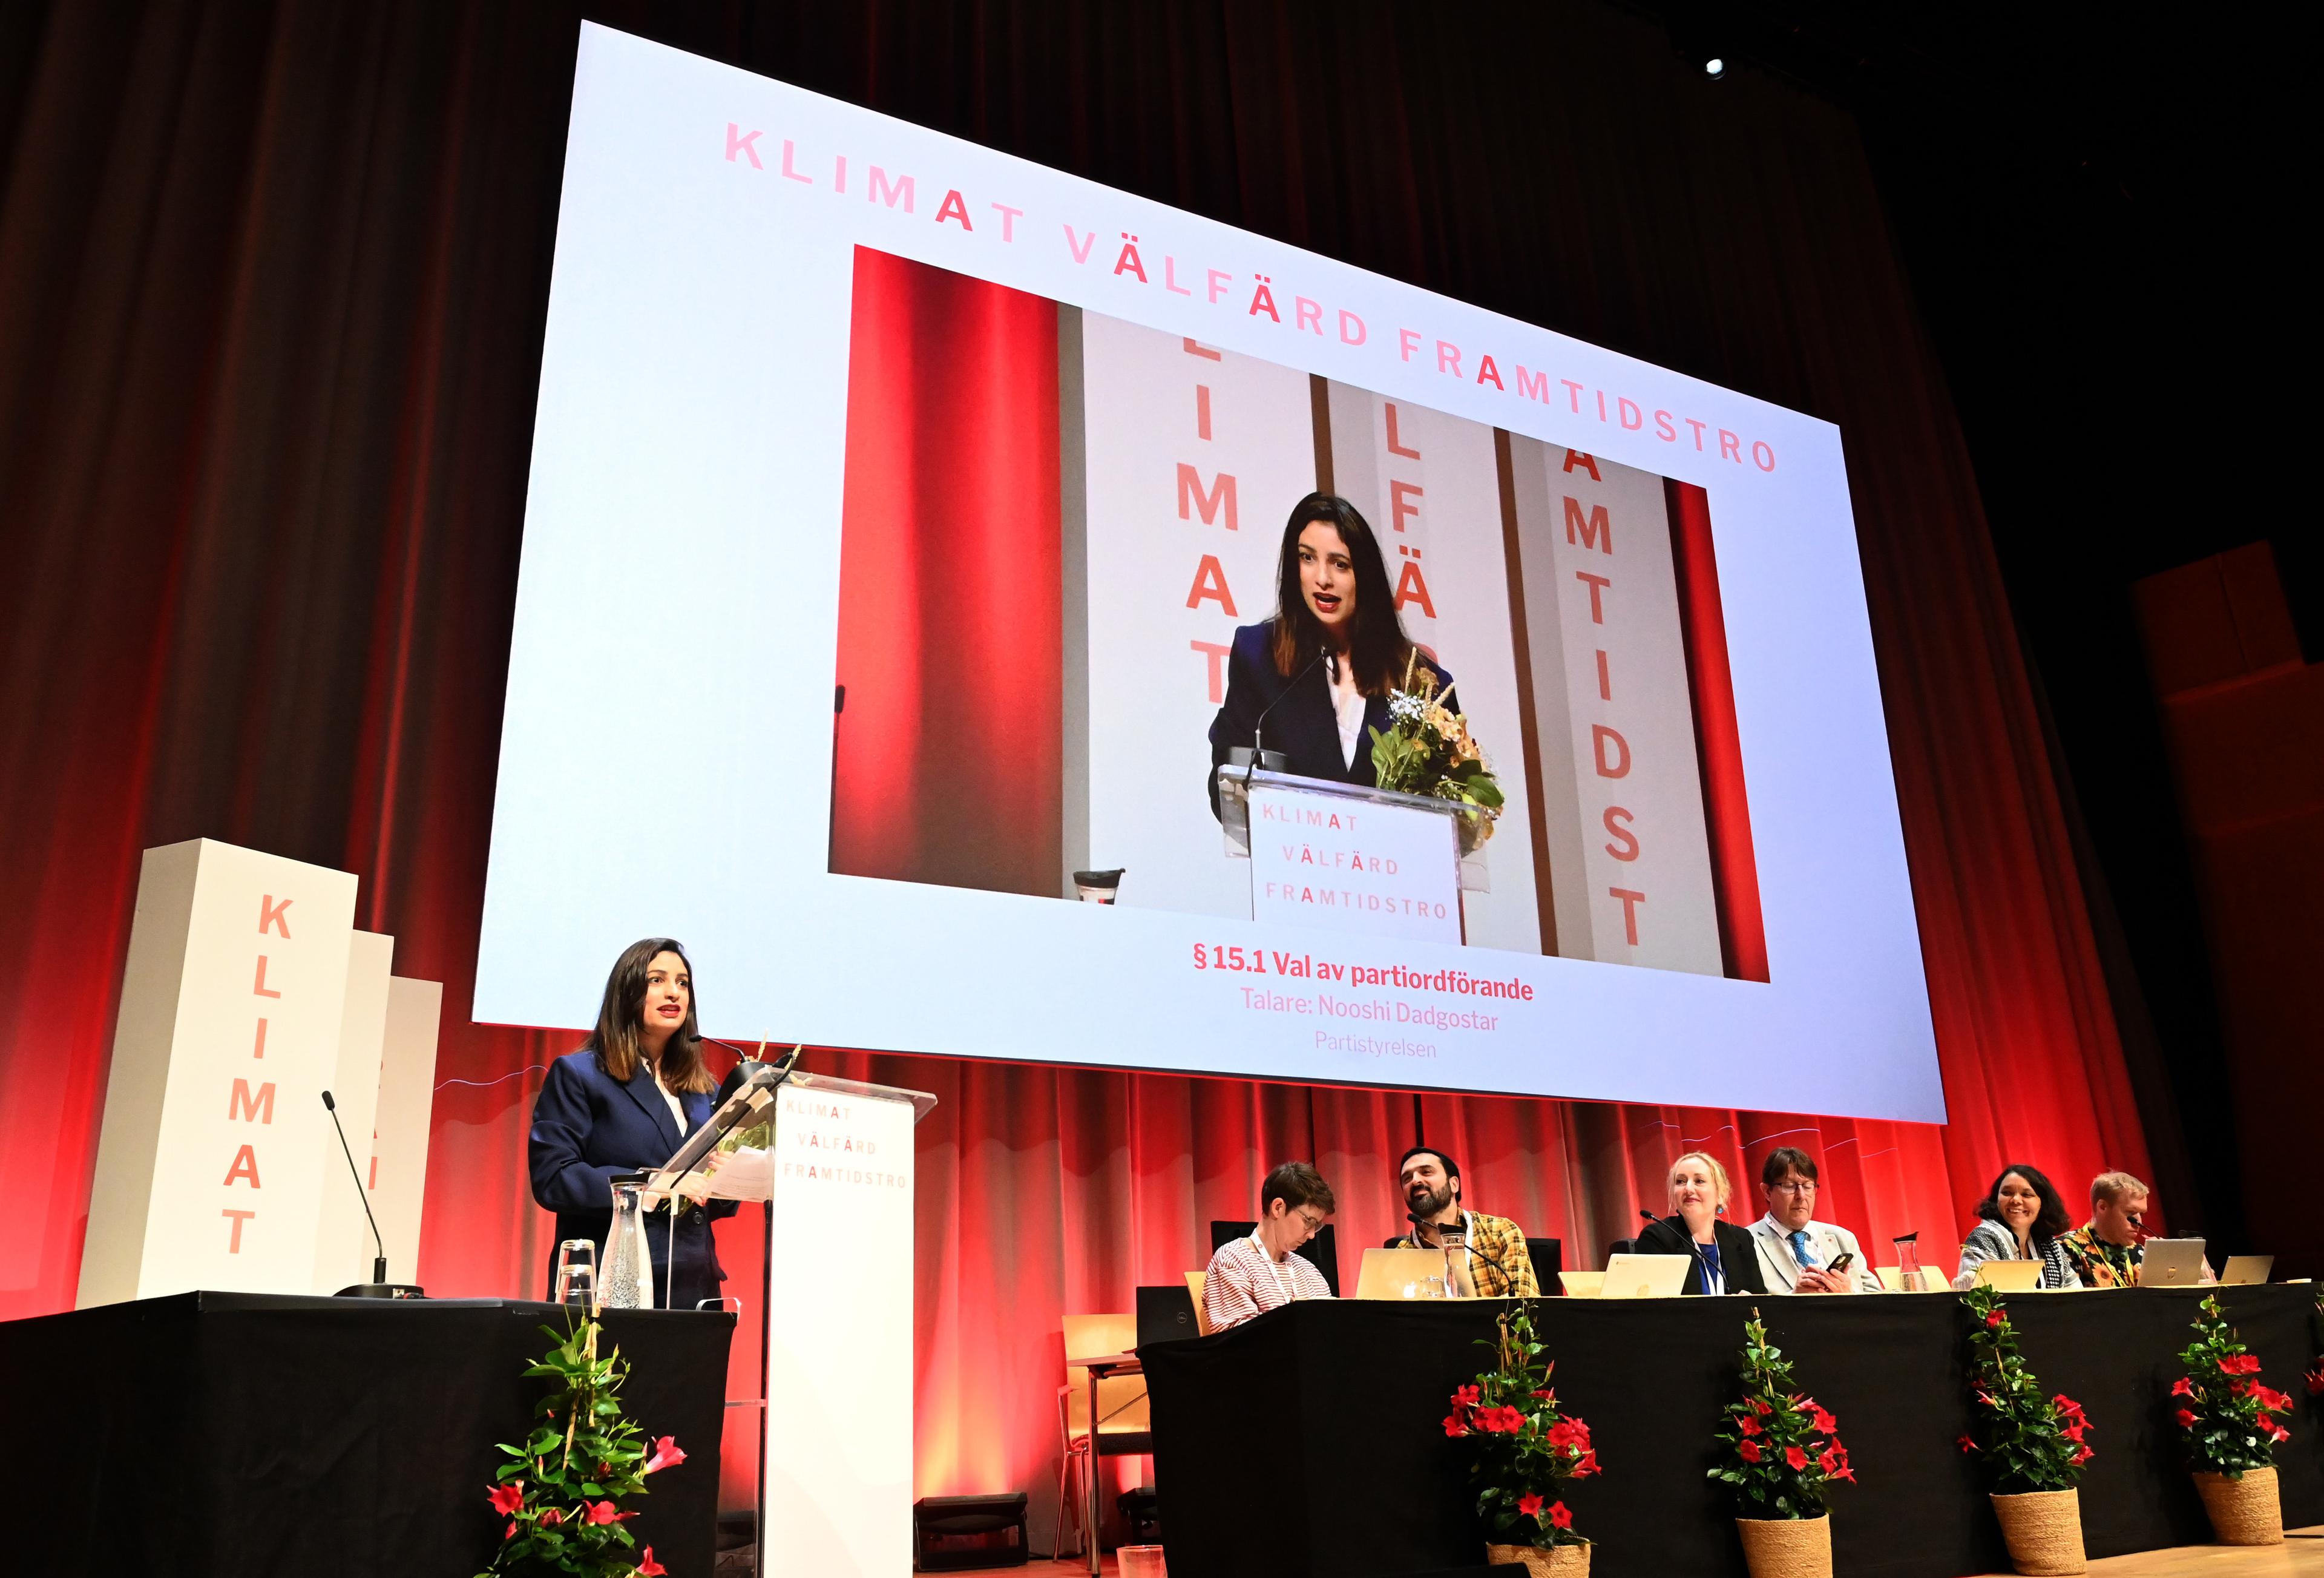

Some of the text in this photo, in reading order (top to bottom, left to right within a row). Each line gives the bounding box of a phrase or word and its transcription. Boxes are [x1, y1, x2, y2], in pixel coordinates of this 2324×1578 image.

[725, 122, 1776, 473] KLIMAT VÄLFÄRD FRAMTIDSTRO
[1384, 403, 1439, 663] LFÄ
[1262, 804, 1357, 831] KLIMAT
[1282, 843, 1399, 875] VÄLFÄRD
[1266, 882, 1447, 920] FRAMTIDSTRO
[1193, 943, 1534, 1001] § 15.1 Val av partiordförande
[1240, 987, 1498, 1030] Talare: Nooshi Dadgostar
[1315, 1031, 1436, 1057] Partistyrelsen
[222, 895, 293, 1254] KLIMAT
[786, 1100, 851, 1120] KLIMAT
[798, 1131, 876, 1155] VÄLFÄRD
[784, 1162, 907, 1189] FRAMTIDSTRO
